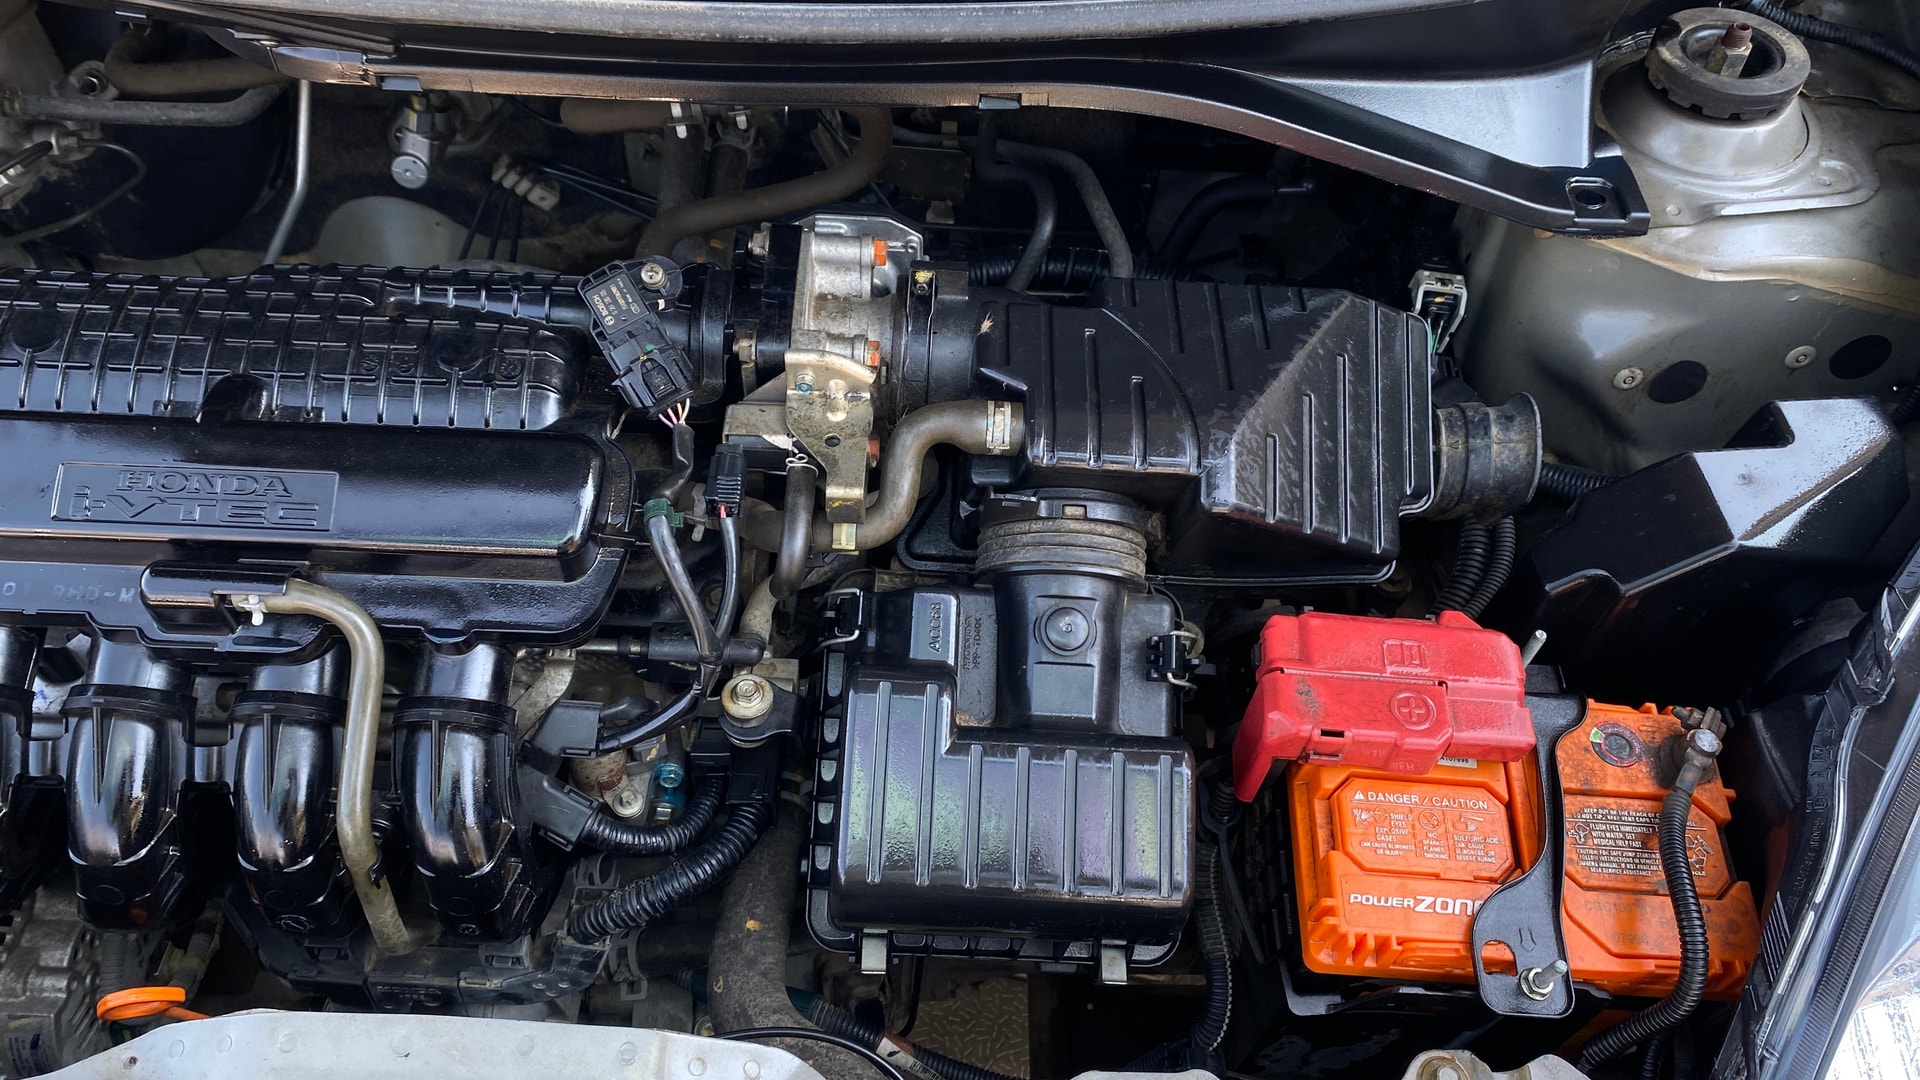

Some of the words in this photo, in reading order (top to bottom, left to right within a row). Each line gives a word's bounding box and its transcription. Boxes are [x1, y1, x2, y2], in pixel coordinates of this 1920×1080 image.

[592, 294, 609, 317] BOSCH
[116, 470, 294, 497] HONDA
[69, 486, 320, 527] i-VTEC
[1368, 792, 1419, 804] DANGER
[1432, 797, 1488, 810] CAUTION
[1390, 813, 1413, 821] SHIELD
[1376, 827, 1409, 835] EXPLOSIVE
[1620, 826, 1653, 834] IMMEDIATELY
[1453, 835, 1484, 843] SULFURIC
